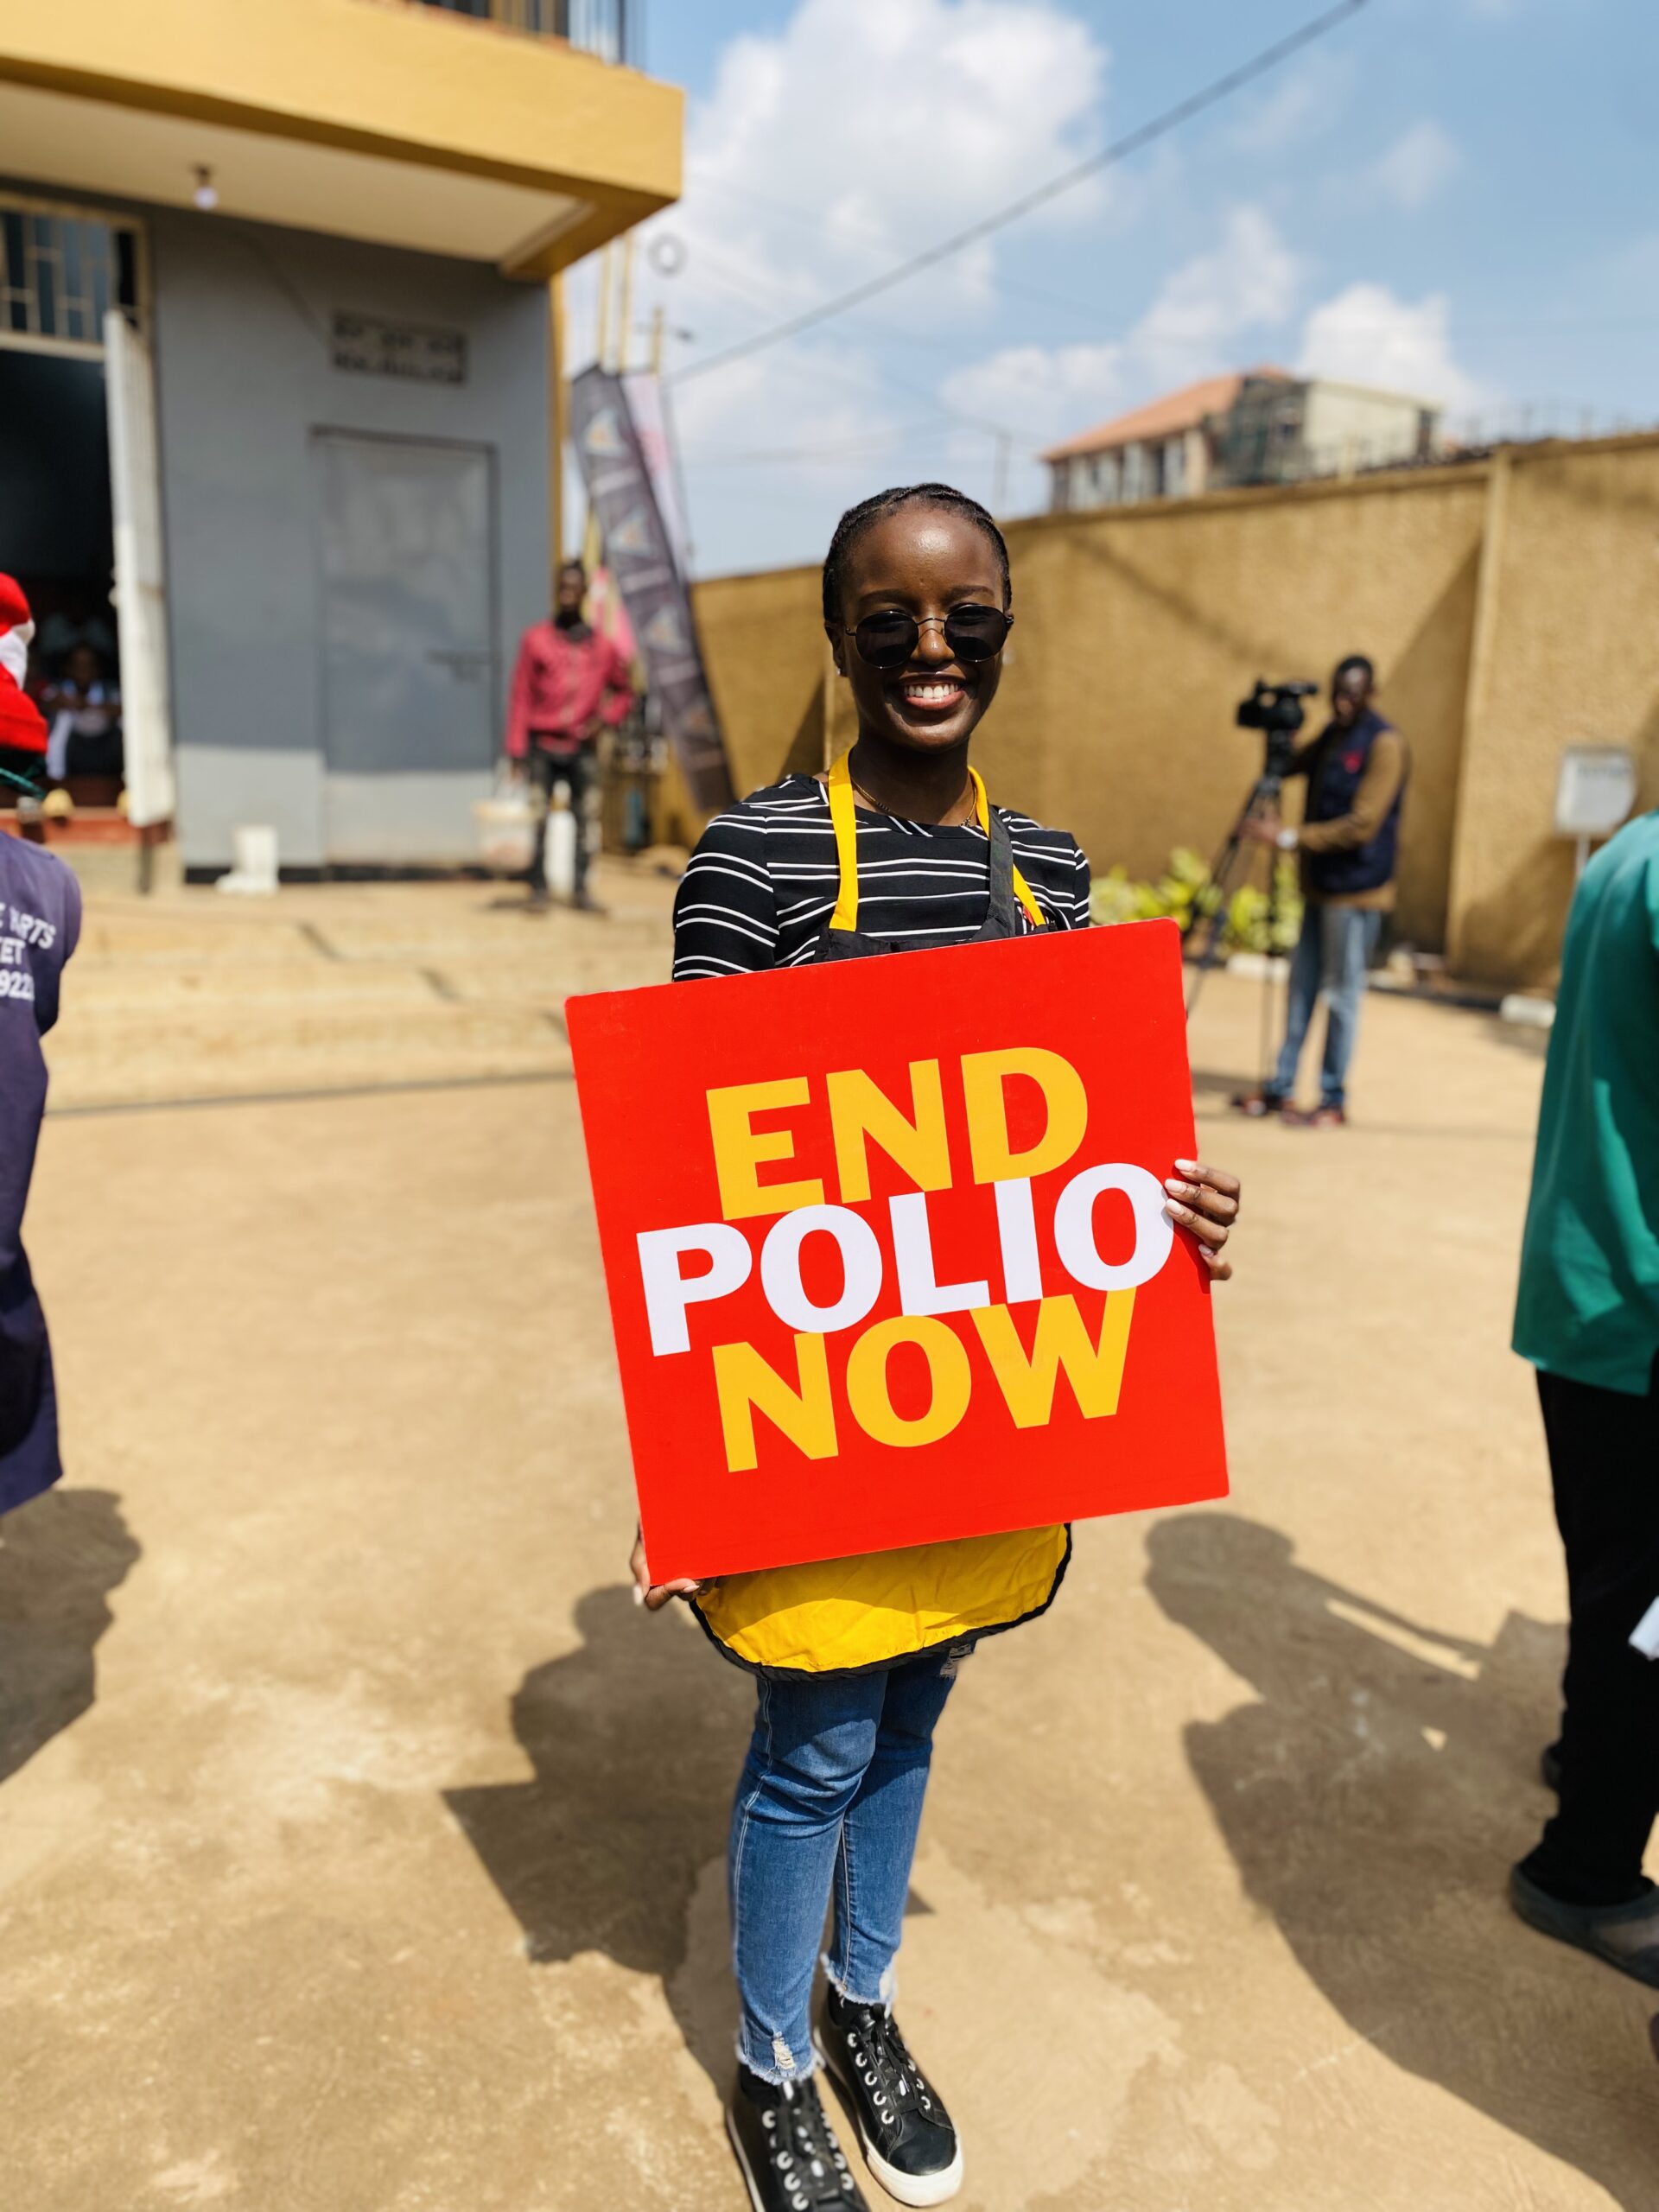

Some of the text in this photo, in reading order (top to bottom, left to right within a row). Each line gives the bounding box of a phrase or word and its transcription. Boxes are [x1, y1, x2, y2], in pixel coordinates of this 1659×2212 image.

[705, 1046, 1088, 1221] END
[636, 1162, 1174, 1357] POLIO
[711, 1285, 1137, 1473] NOW
